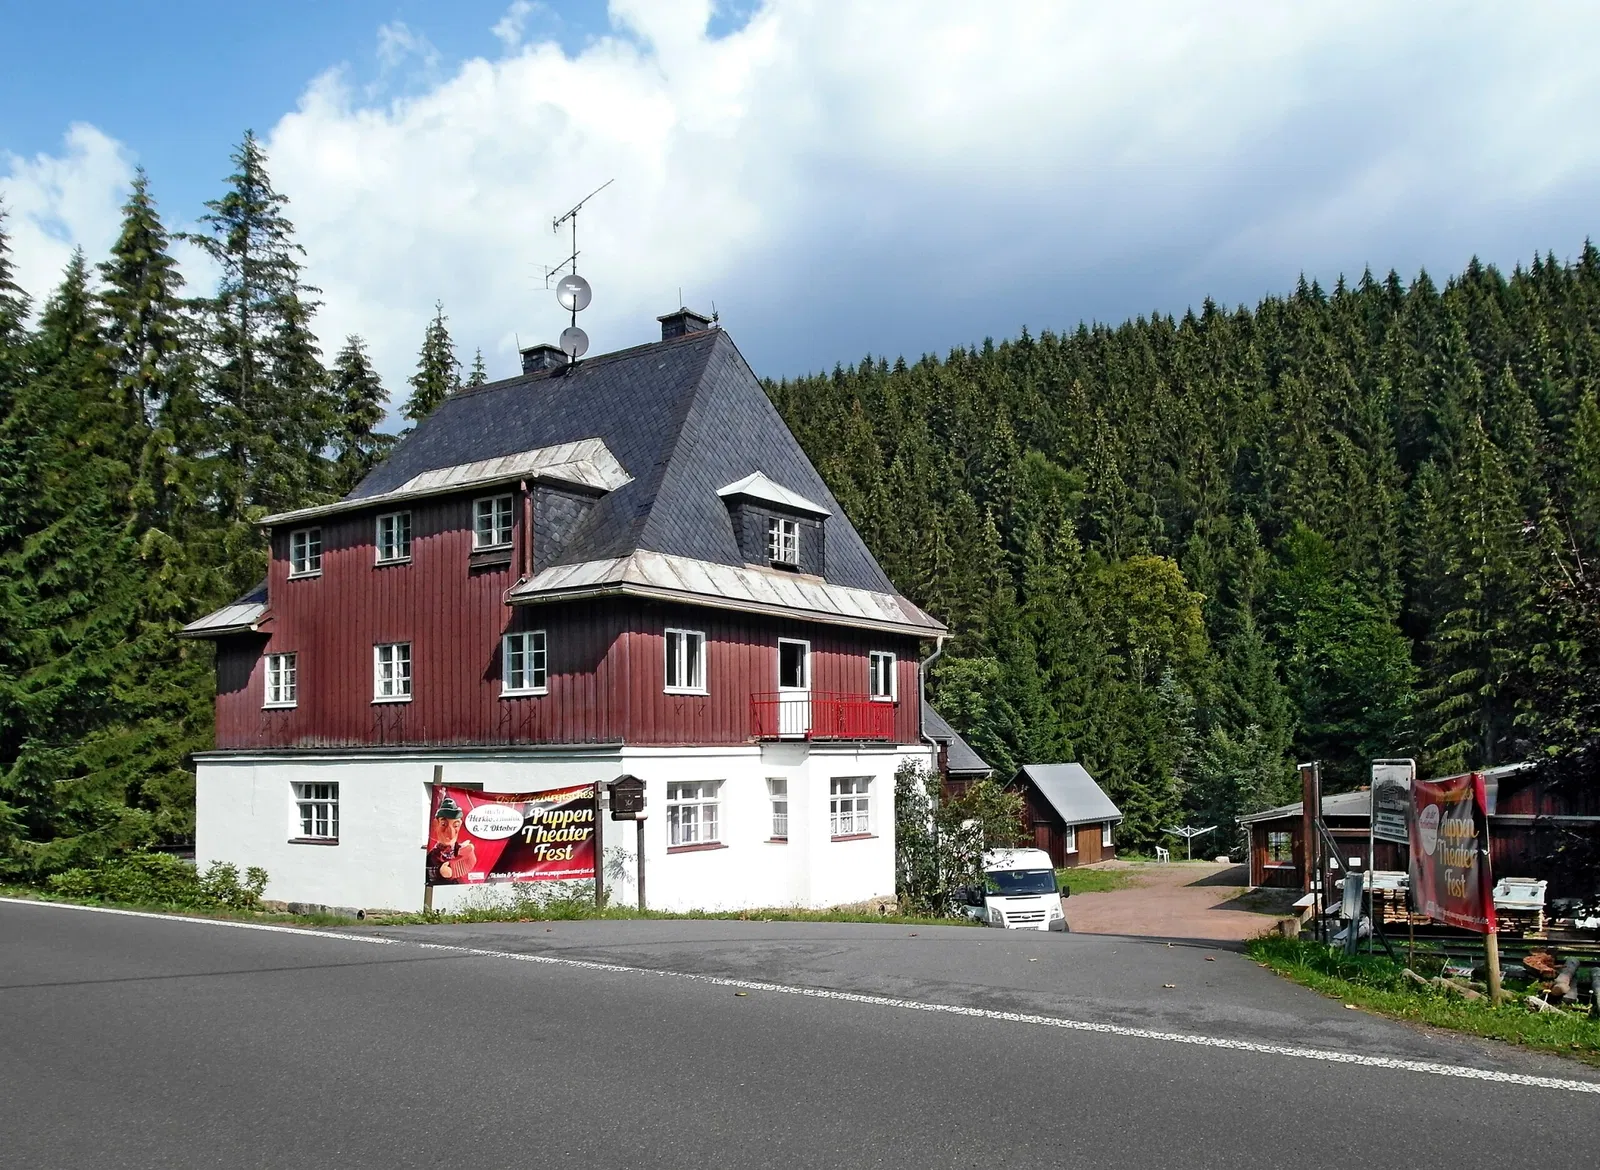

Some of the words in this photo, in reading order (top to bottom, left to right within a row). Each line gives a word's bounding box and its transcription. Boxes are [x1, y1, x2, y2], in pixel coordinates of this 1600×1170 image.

[490, 824, 518, 832] Oktober
[525, 807, 595, 829] Puppen
[521, 825, 593, 844] Theater
[534, 844, 574, 862] Fest
[1437, 839, 1478, 869] Theater
[1445, 869, 1466, 899] Fest
